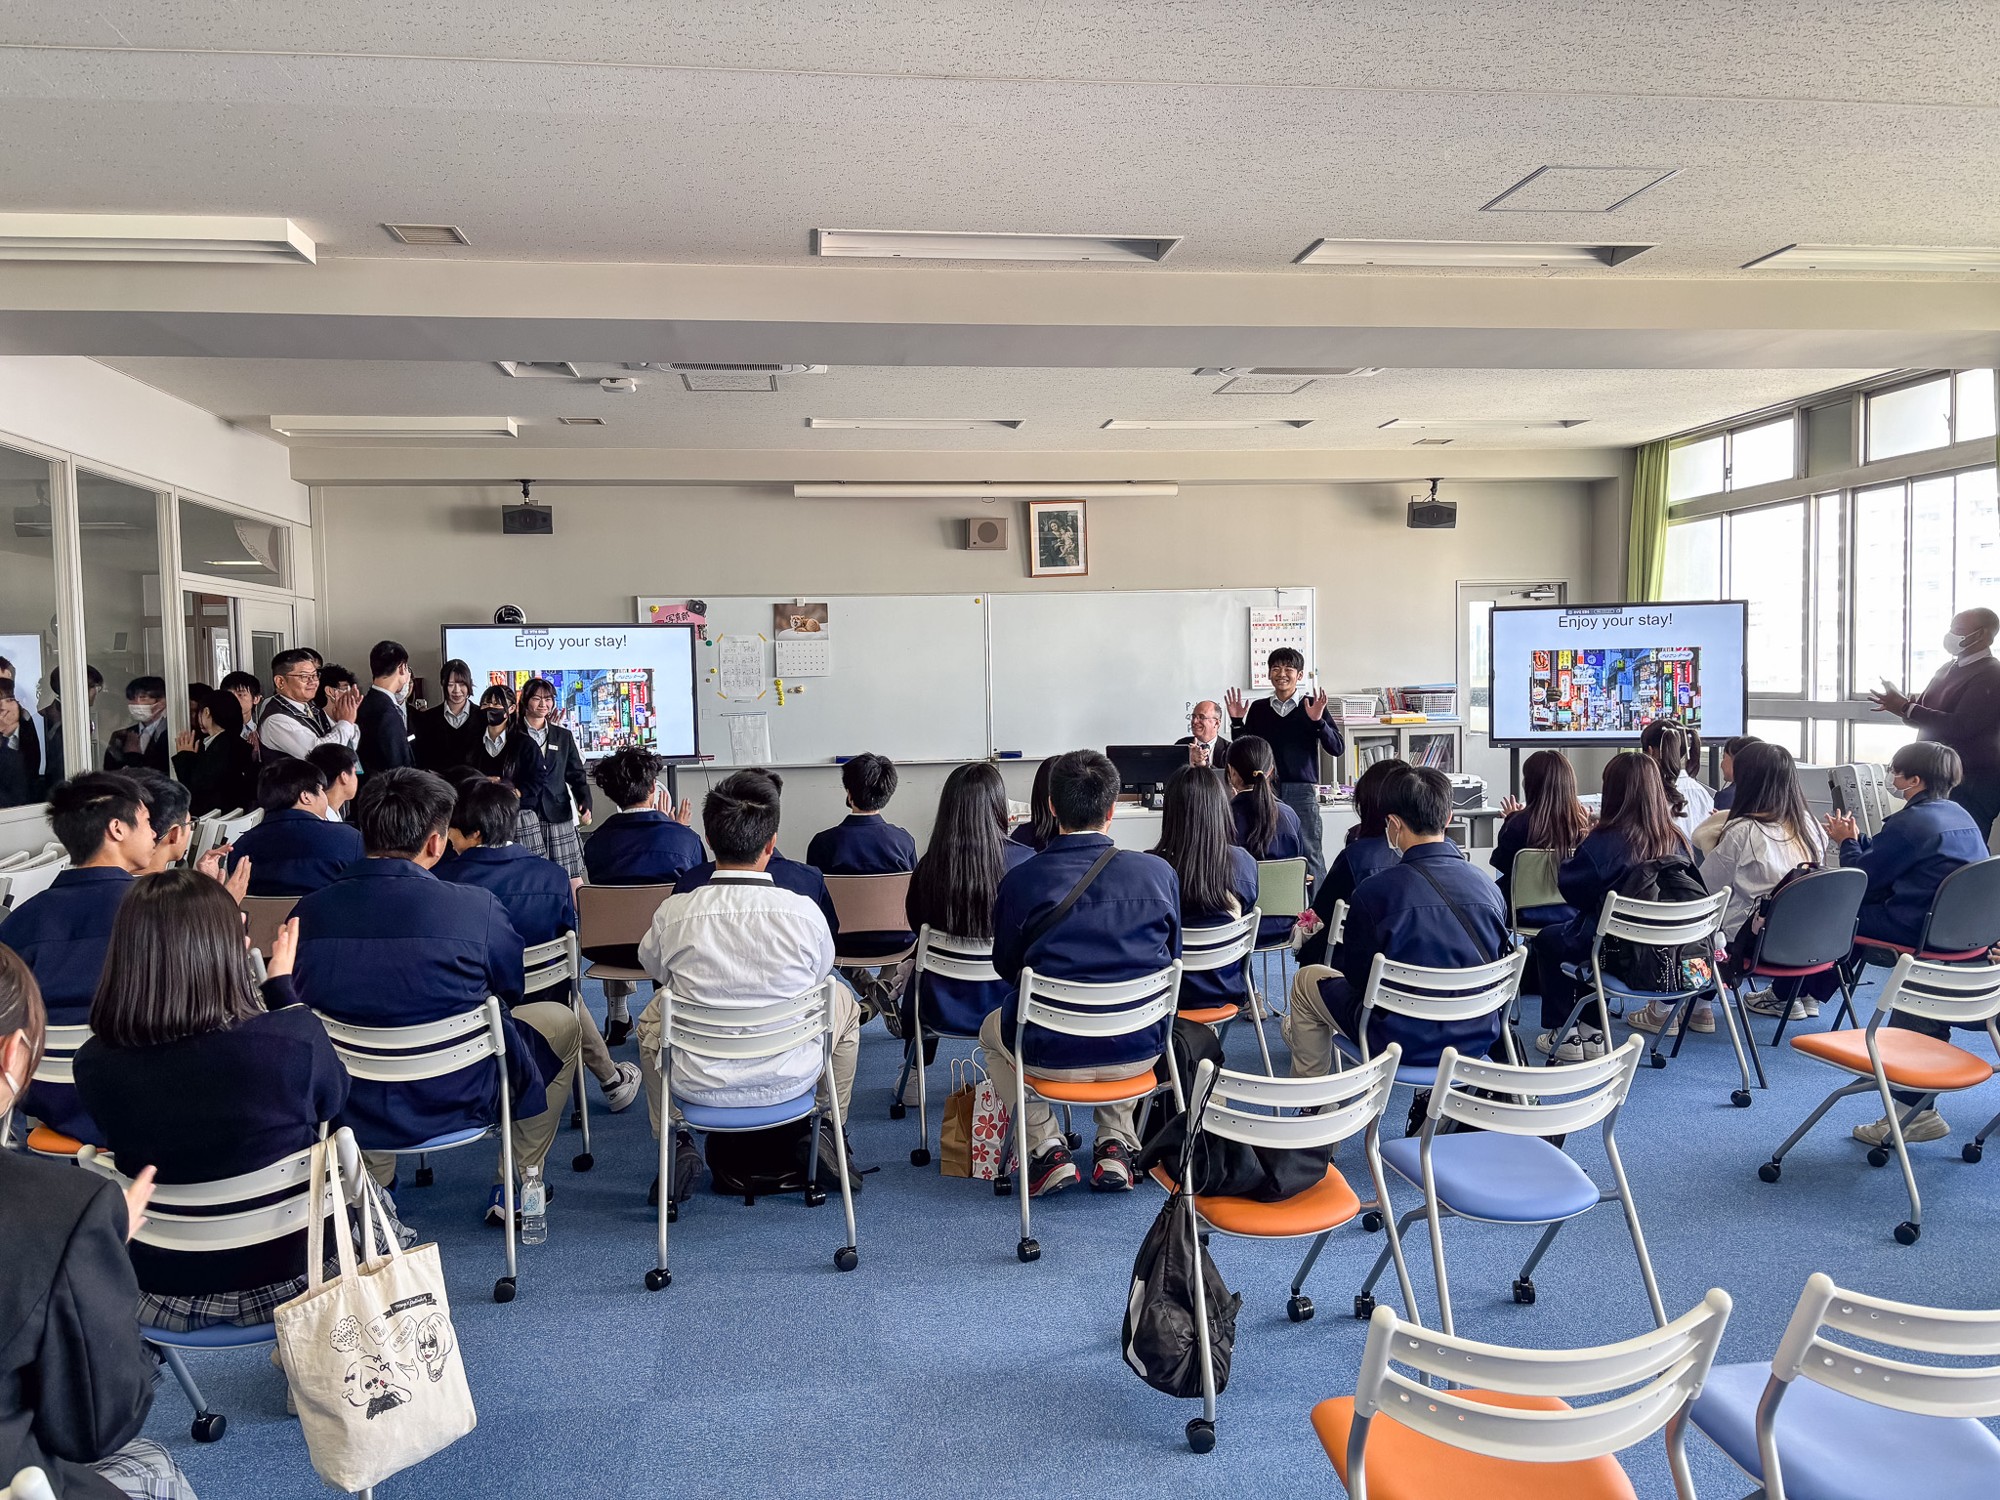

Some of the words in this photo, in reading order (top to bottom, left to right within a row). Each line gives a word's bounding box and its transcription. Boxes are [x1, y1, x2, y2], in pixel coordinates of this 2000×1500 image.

[1558, 615, 1598, 630] Enjoy
[1602, 616, 1634, 630] your
[1638, 613, 1672, 628] stay!
[515, 635, 554, 650] Enjoy
[559, 637, 590, 650] your
[594, 635, 627, 649] stay!
